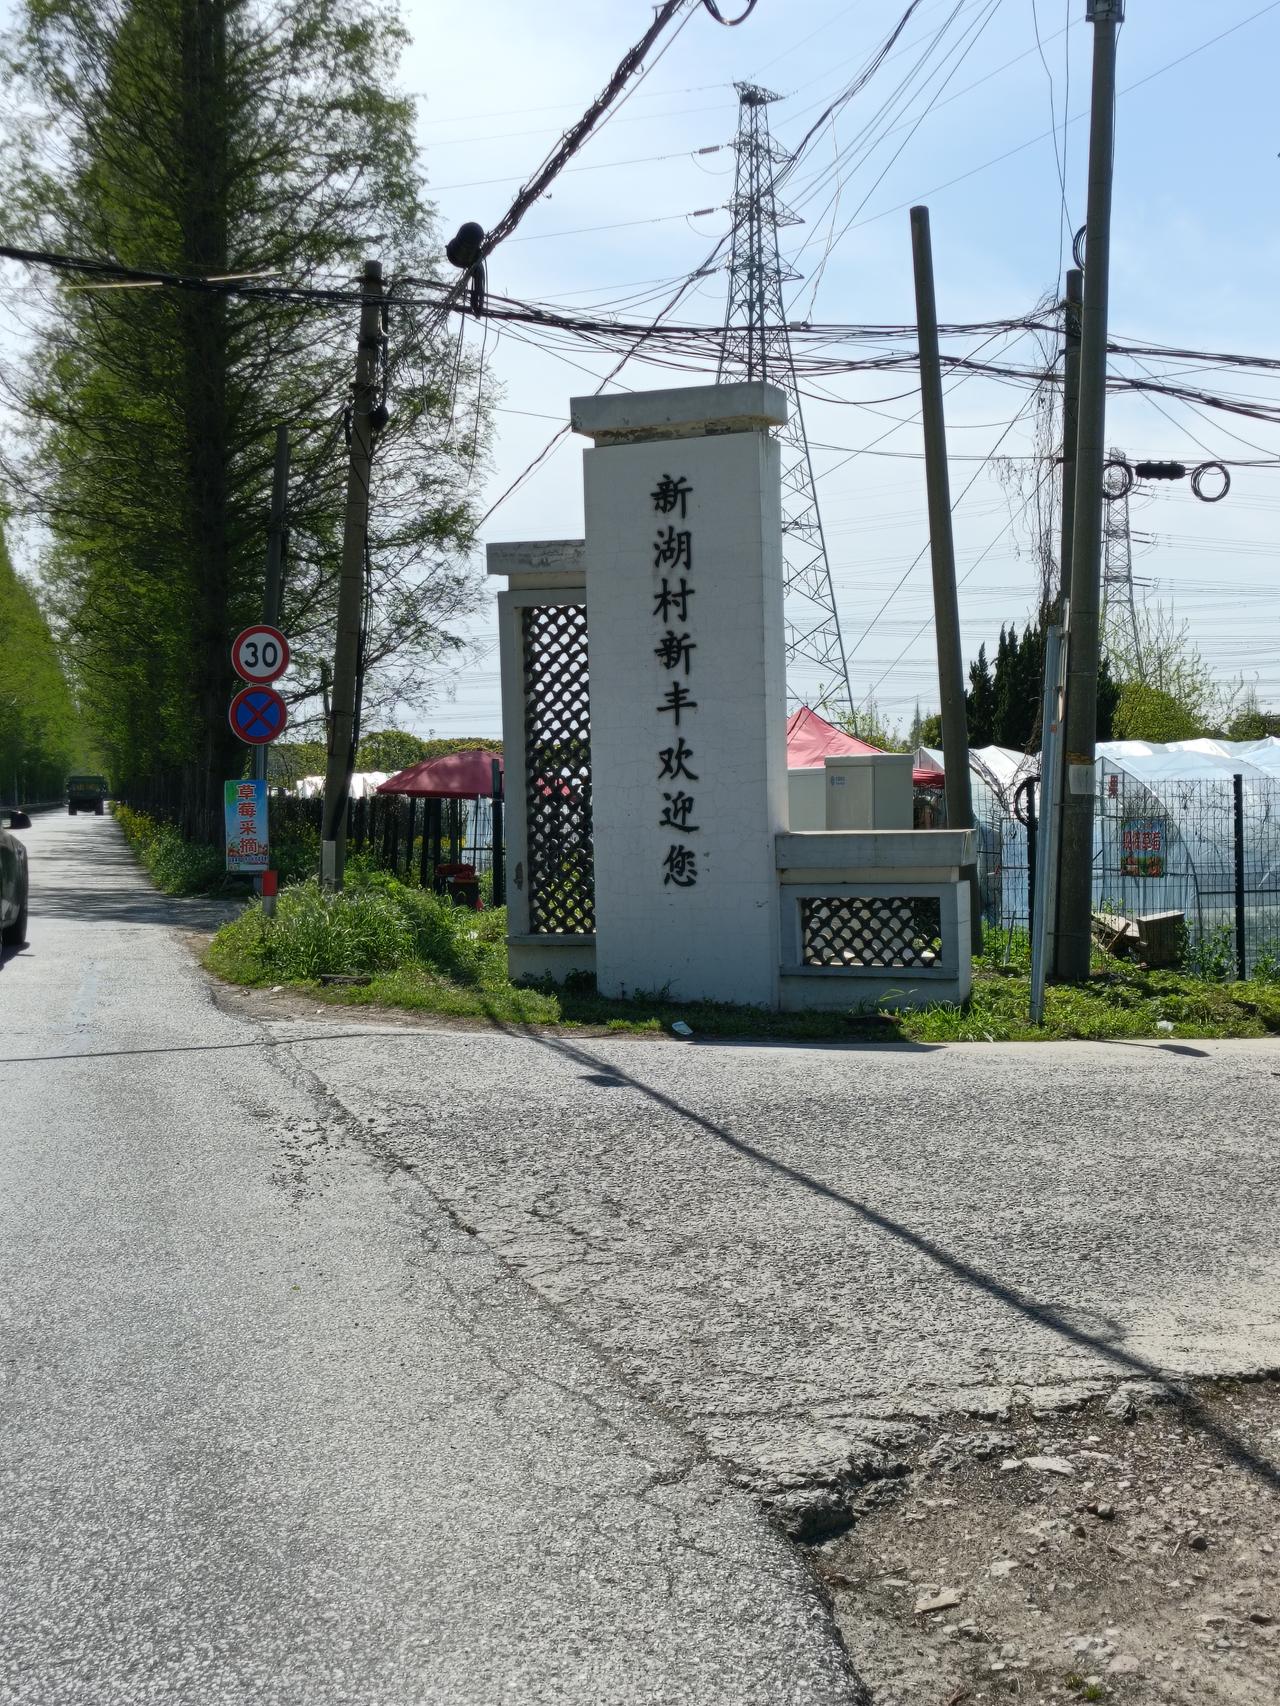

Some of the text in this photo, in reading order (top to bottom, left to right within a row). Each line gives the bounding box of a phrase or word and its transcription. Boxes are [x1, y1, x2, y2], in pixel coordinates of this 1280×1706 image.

[244, 641, 278, 668] 30
[650, 473, 700, 887] 新湖村新丰欢迎您
[236, 784, 257, 854] 草莓采摘
